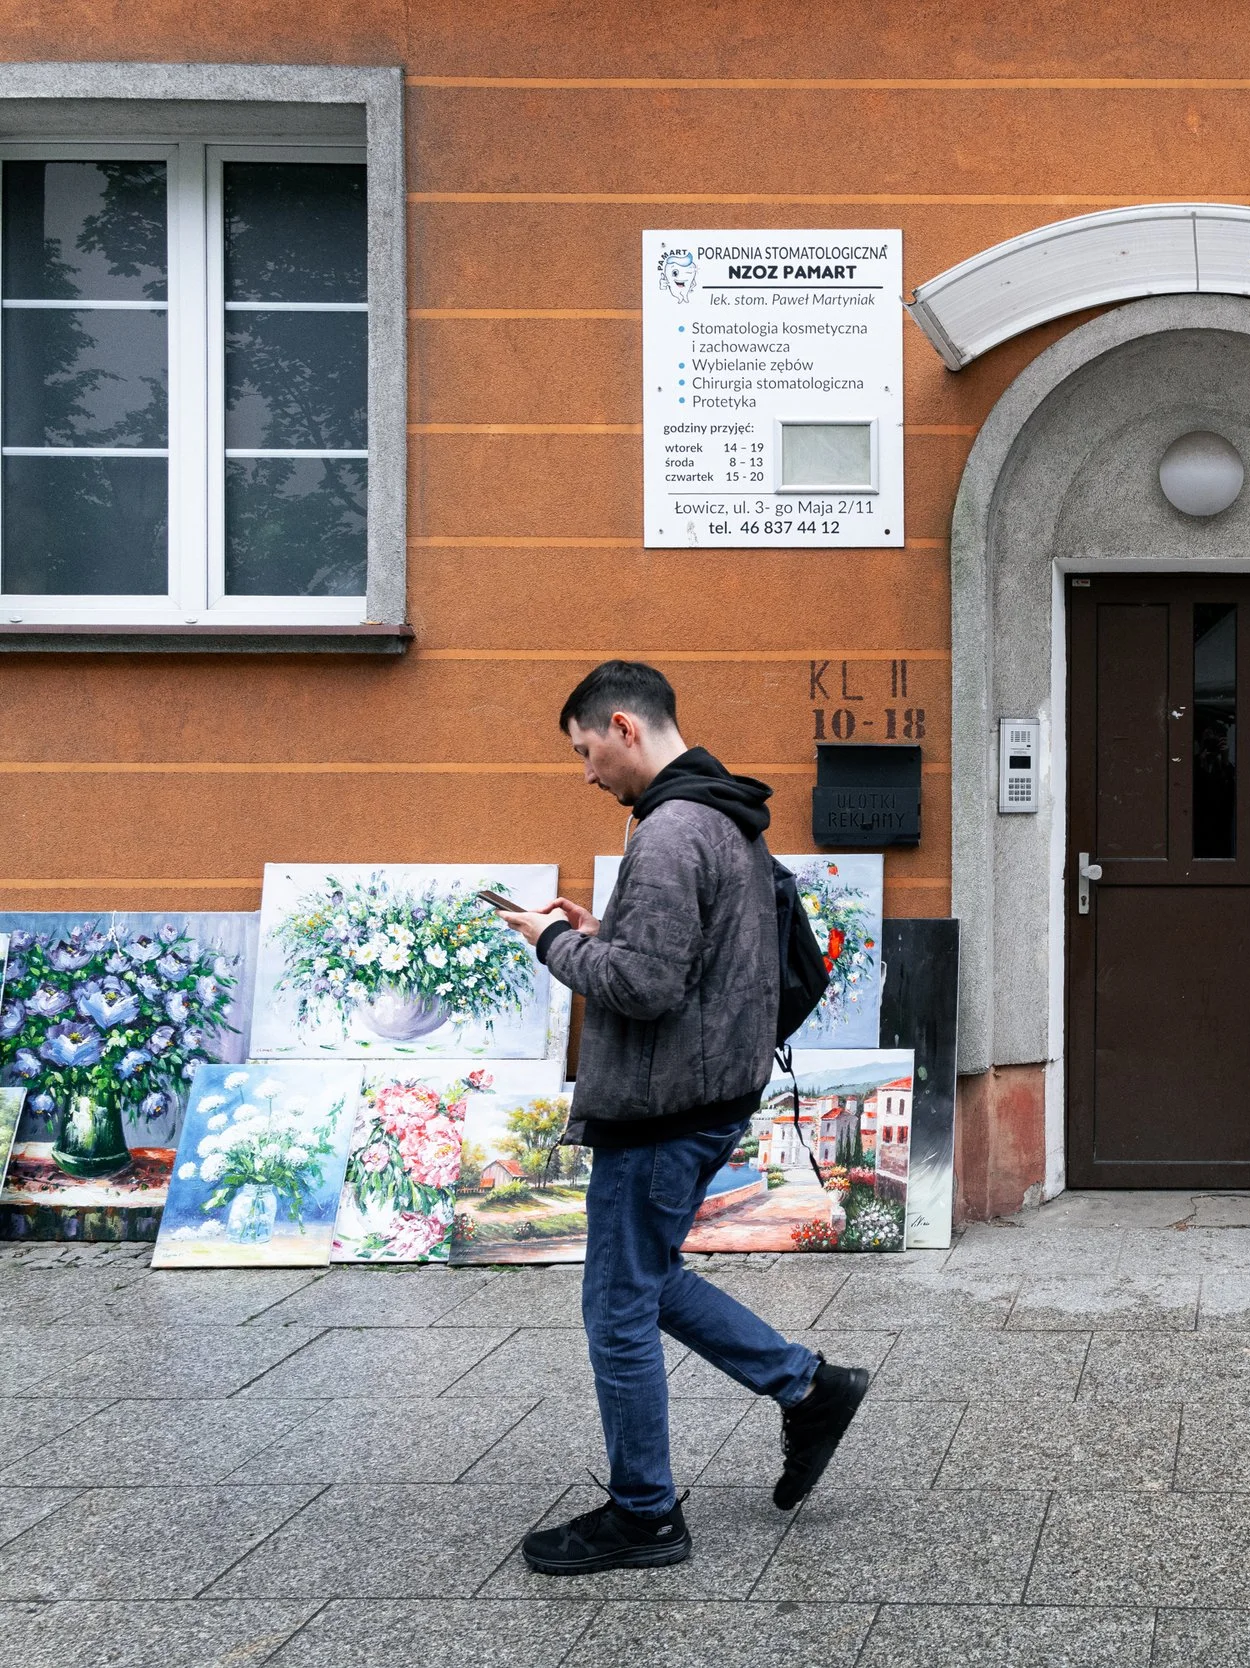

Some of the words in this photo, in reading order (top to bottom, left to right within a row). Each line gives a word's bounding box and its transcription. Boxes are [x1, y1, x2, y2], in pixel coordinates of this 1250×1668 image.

[656, 248, 687, 271] PAMART
[698, 247, 762, 260] PORADNIA
[765, 246, 888, 260] STOMATOLOGICZNA
[729, 265, 778, 279] NZOZ
[783, 265, 857, 279] PAMART
[711, 294, 730, 305] lek.
[735, 295, 767, 305] stom.
[772, 294, 809, 305] Paweł
[813, 294, 875, 307] Martyniak
[692, 322, 778, 337] Stomatologia
[783, 322, 867, 336] kosmetyczna
[692, 340, 696, 353] i
[700, 340, 789, 352] zachowawcza
[692, 359, 766, 373] Wybielanie
[771, 358, 813, 373] zębów
[693, 377, 752, 392] Chirurgia
[757, 377, 863, 392] stomatologiczna
[693, 395, 756, 410] Protetyka
[664, 423, 707, 435] godziny
[711, 423, 754, 435] przyjęć:
[665, 443, 703, 452] wtorek
[724, 443, 737, 452] 14
[751, 443, 764, 452] 19
[665, 457, 694, 467] środa
[730, 457, 736, 467] 8
[750, 457, 763, 467] 13
[665, 472, 714, 481] czwartek
[726, 472, 739, 481] 15
[750, 472, 764, 481] 20
[675, 501, 728, 516] Łowicz,
[734, 501, 749, 514] ul.
[775, 504, 793, 517] go
[798, 501, 832, 516] Maja
[838, 500, 873, 514] 2/11
[709, 521, 731, 534] tel.
[740, 521, 759, 534] 46
[764, 521, 792, 534] 837
[797, 521, 816, 534] 44
[822, 521, 839, 534] 12
[836, 793, 896, 809] ULOTKI
[828, 812, 906, 828] REKLAMY
